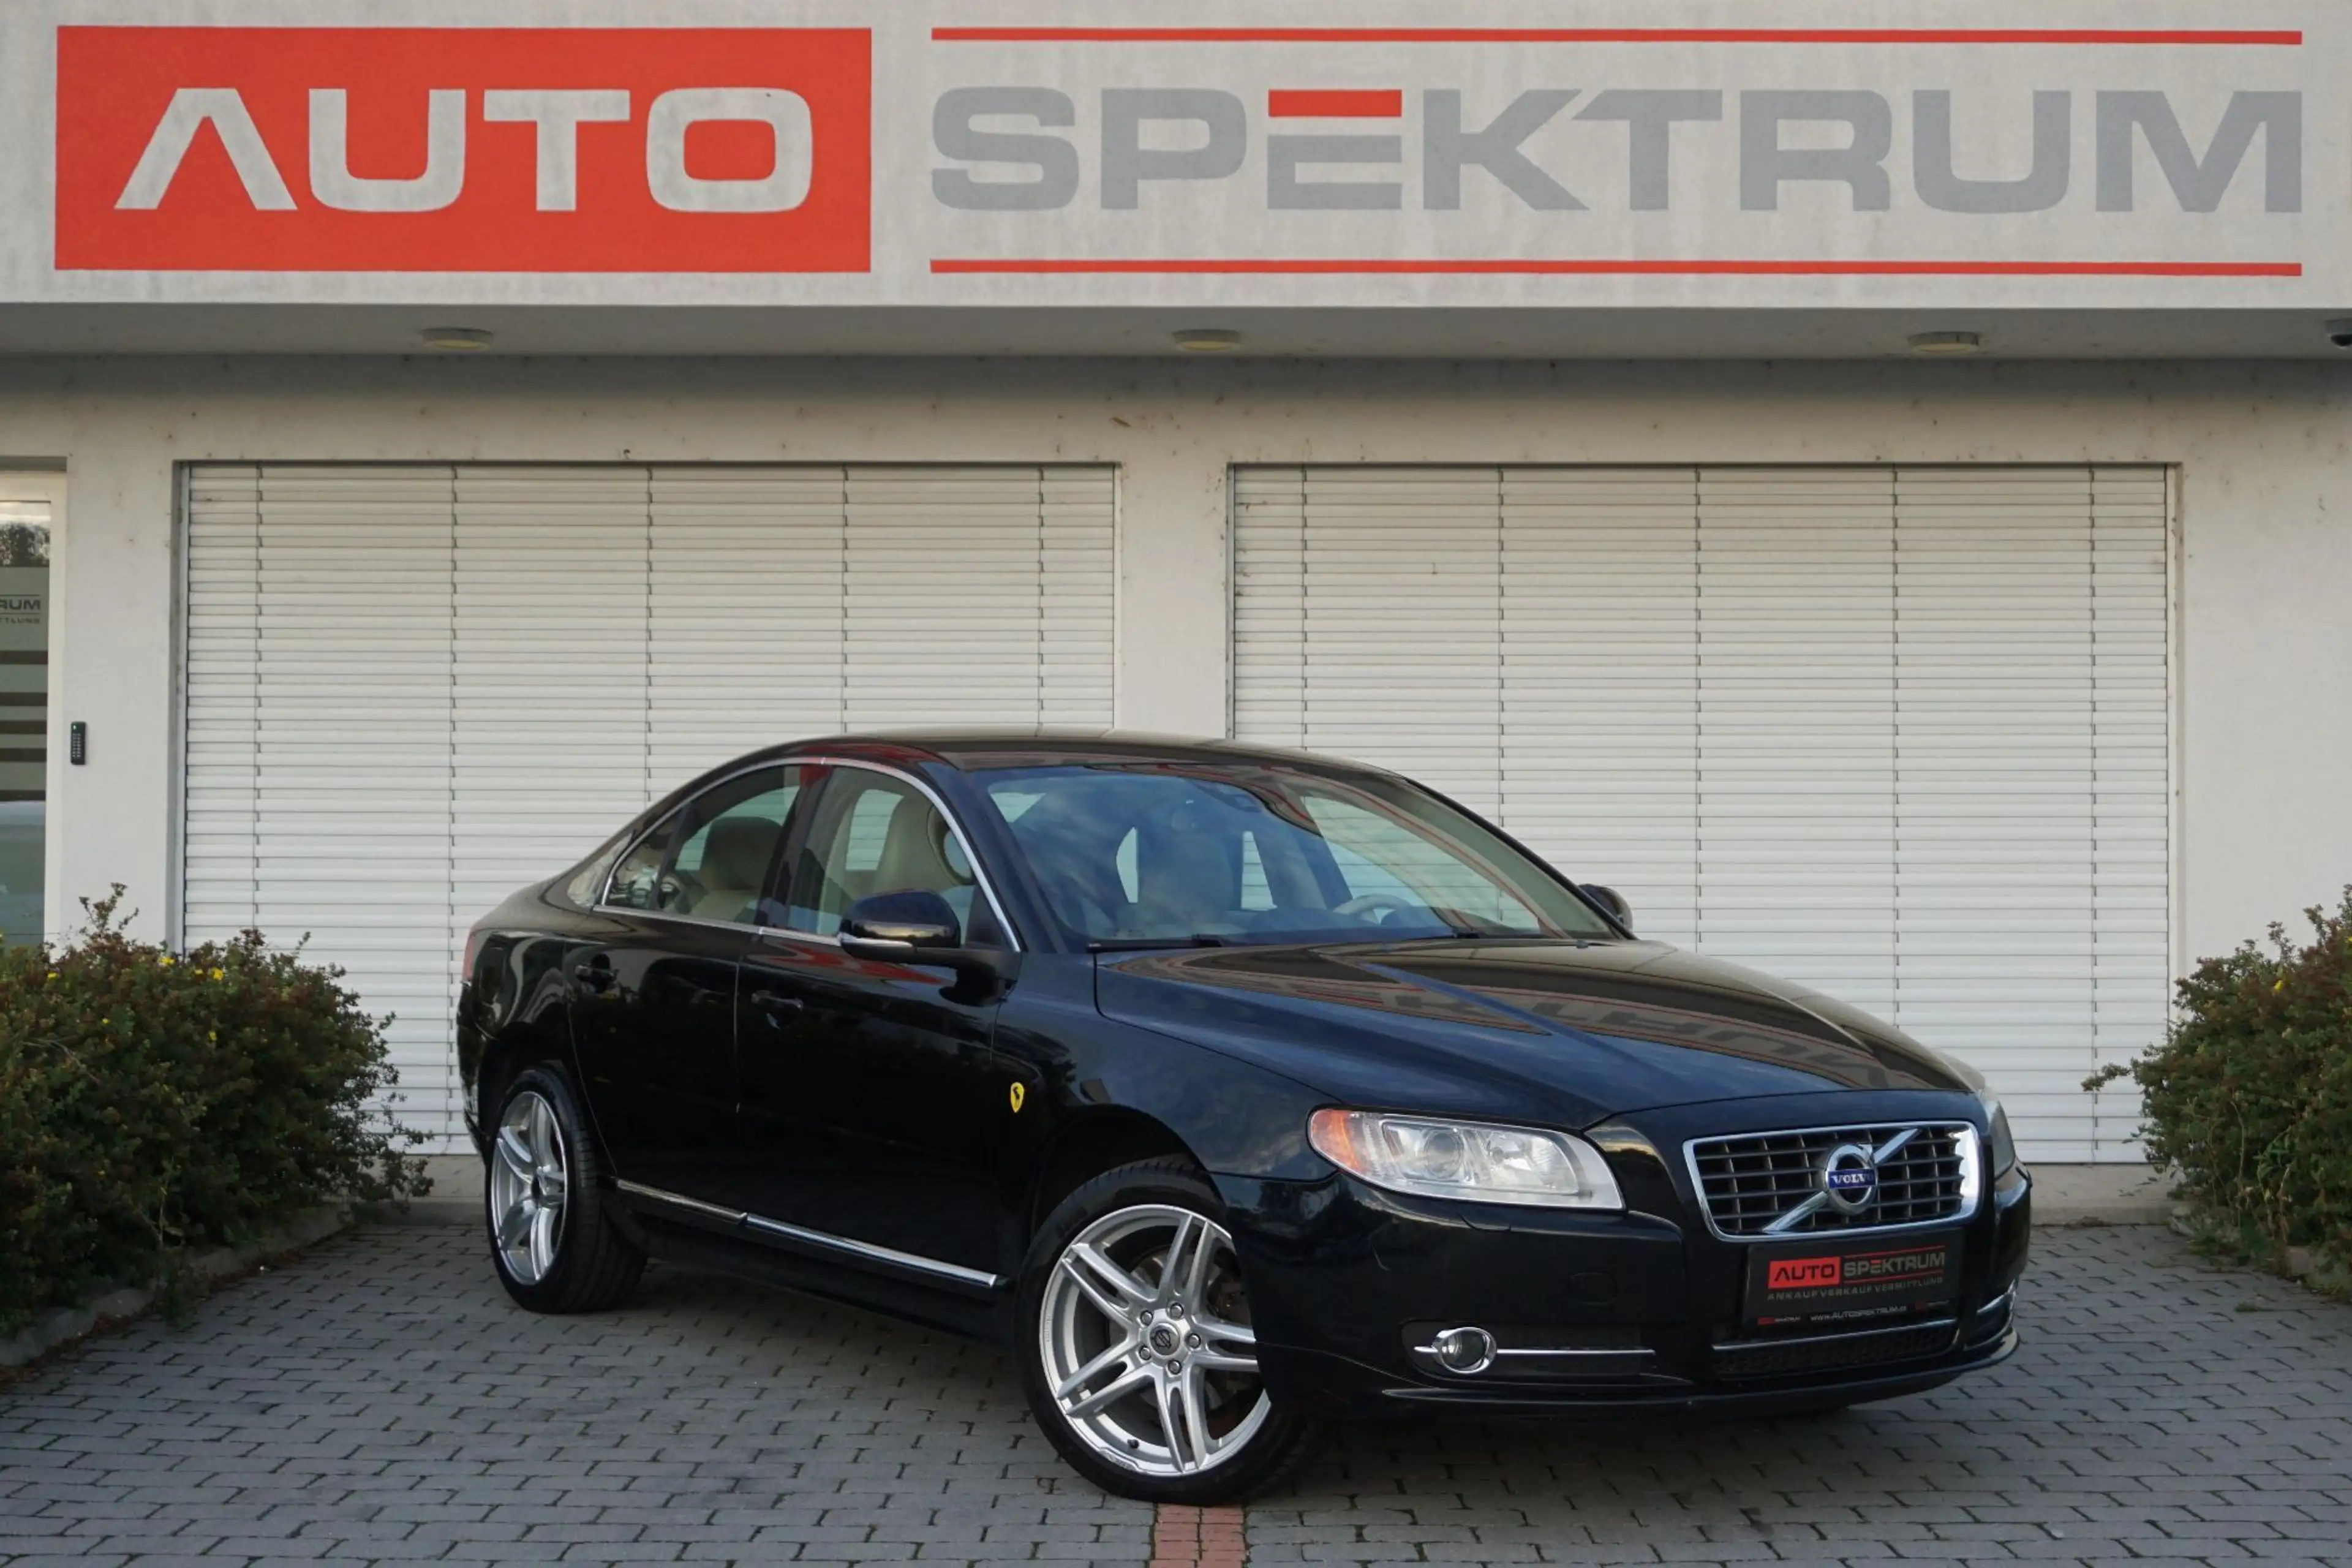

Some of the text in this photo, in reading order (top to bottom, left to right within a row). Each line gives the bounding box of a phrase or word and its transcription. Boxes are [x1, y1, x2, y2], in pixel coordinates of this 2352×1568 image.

[115, 87, 2302, 213] AUTO SPEKTRUM
[1830, 1173, 1874, 1184] VOLVO
[1774, 1252, 1945, 1282] AUTO SPEKTRUM
